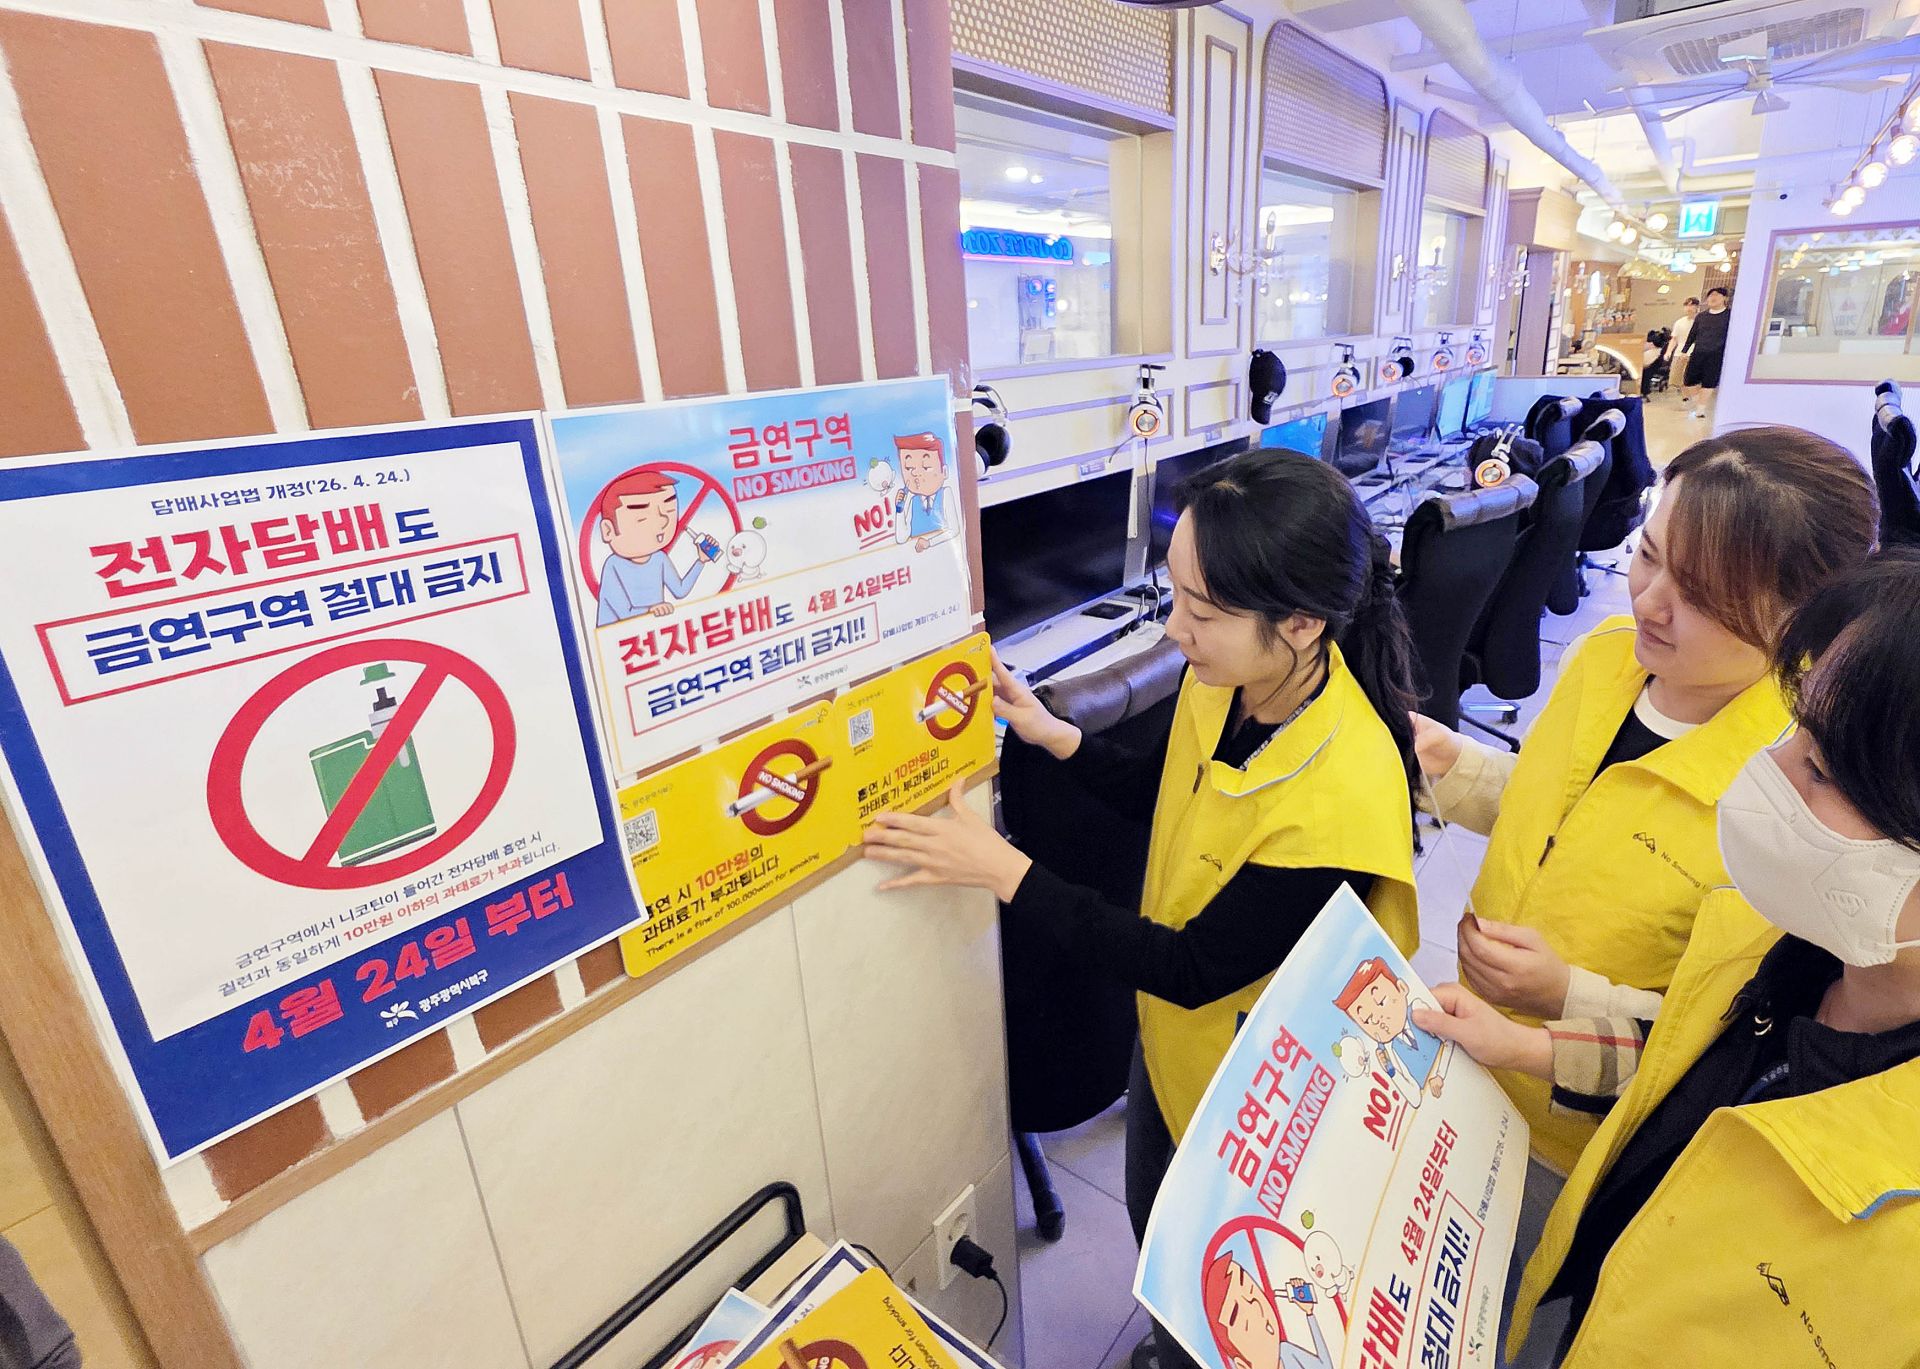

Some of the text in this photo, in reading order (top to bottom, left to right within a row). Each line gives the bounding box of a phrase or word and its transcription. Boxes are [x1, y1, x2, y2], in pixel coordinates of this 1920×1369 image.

[727, 412, 856, 470] 금연구역
[736, 458, 856, 501] NO SMOKING
[151, 487, 260, 518] 담배사업법
[354, 472, 369, 490] 4.
[375, 468, 412, 487] 24.)
[852, 497, 895, 540] NO!
[89, 502, 440, 599] 전자담배도
[85, 551, 503, 676] 금연구역 절대 금지
[618, 565, 912, 676] 전자담배도 4월 24일부터
[647, 616, 867, 719] 금연구역 절대 금지!!
[758, 770, 805, 801] NO SMOKING
[882, 772, 892, 789] 시
[894, 746, 939, 780] 10만원의
[235, 831, 543, 970] 금연구역에서 니코틴이 들어간 전자담배 흡연 시
[642, 896, 706, 943] 과태료가
[710, 854, 779, 902] 부과됩니다
[646, 938, 674, 957] There
[714, 907, 724, 918] of
[775, 872, 788, 882] for
[789, 852, 820, 874] smoking
[677, 884, 692, 903] 시
[695, 843, 764, 892] 10만원의
[1660, 850, 1672, 864] No
[1671, 860, 1702, 889] Smoking
[218, 965, 272, 998] 궐련과
[276, 935, 342, 973] 동일하게
[343, 911, 395, 942] 10만원
[396, 893, 440, 918] 이하의
[442, 869, 495, 900] 과태료가
[242, 871, 575, 1054] 4월 24일 부터
[418, 968, 489, 1013] 광주광역시북구
[1217, 1024, 1313, 1188] 금연구역
[1257, 1068, 1334, 1214] NO SMOKING
[1363, 1071, 1400, 1141] NO!
[1400, 1215, 1426, 1266] 4월
[1413, 1119, 1458, 1222] 24일부터
[1434, 1216, 1471, 1308] 금지!!
[882, 1296, 907, 1327] smoking
[1800, 1310, 1814, 1334] No
